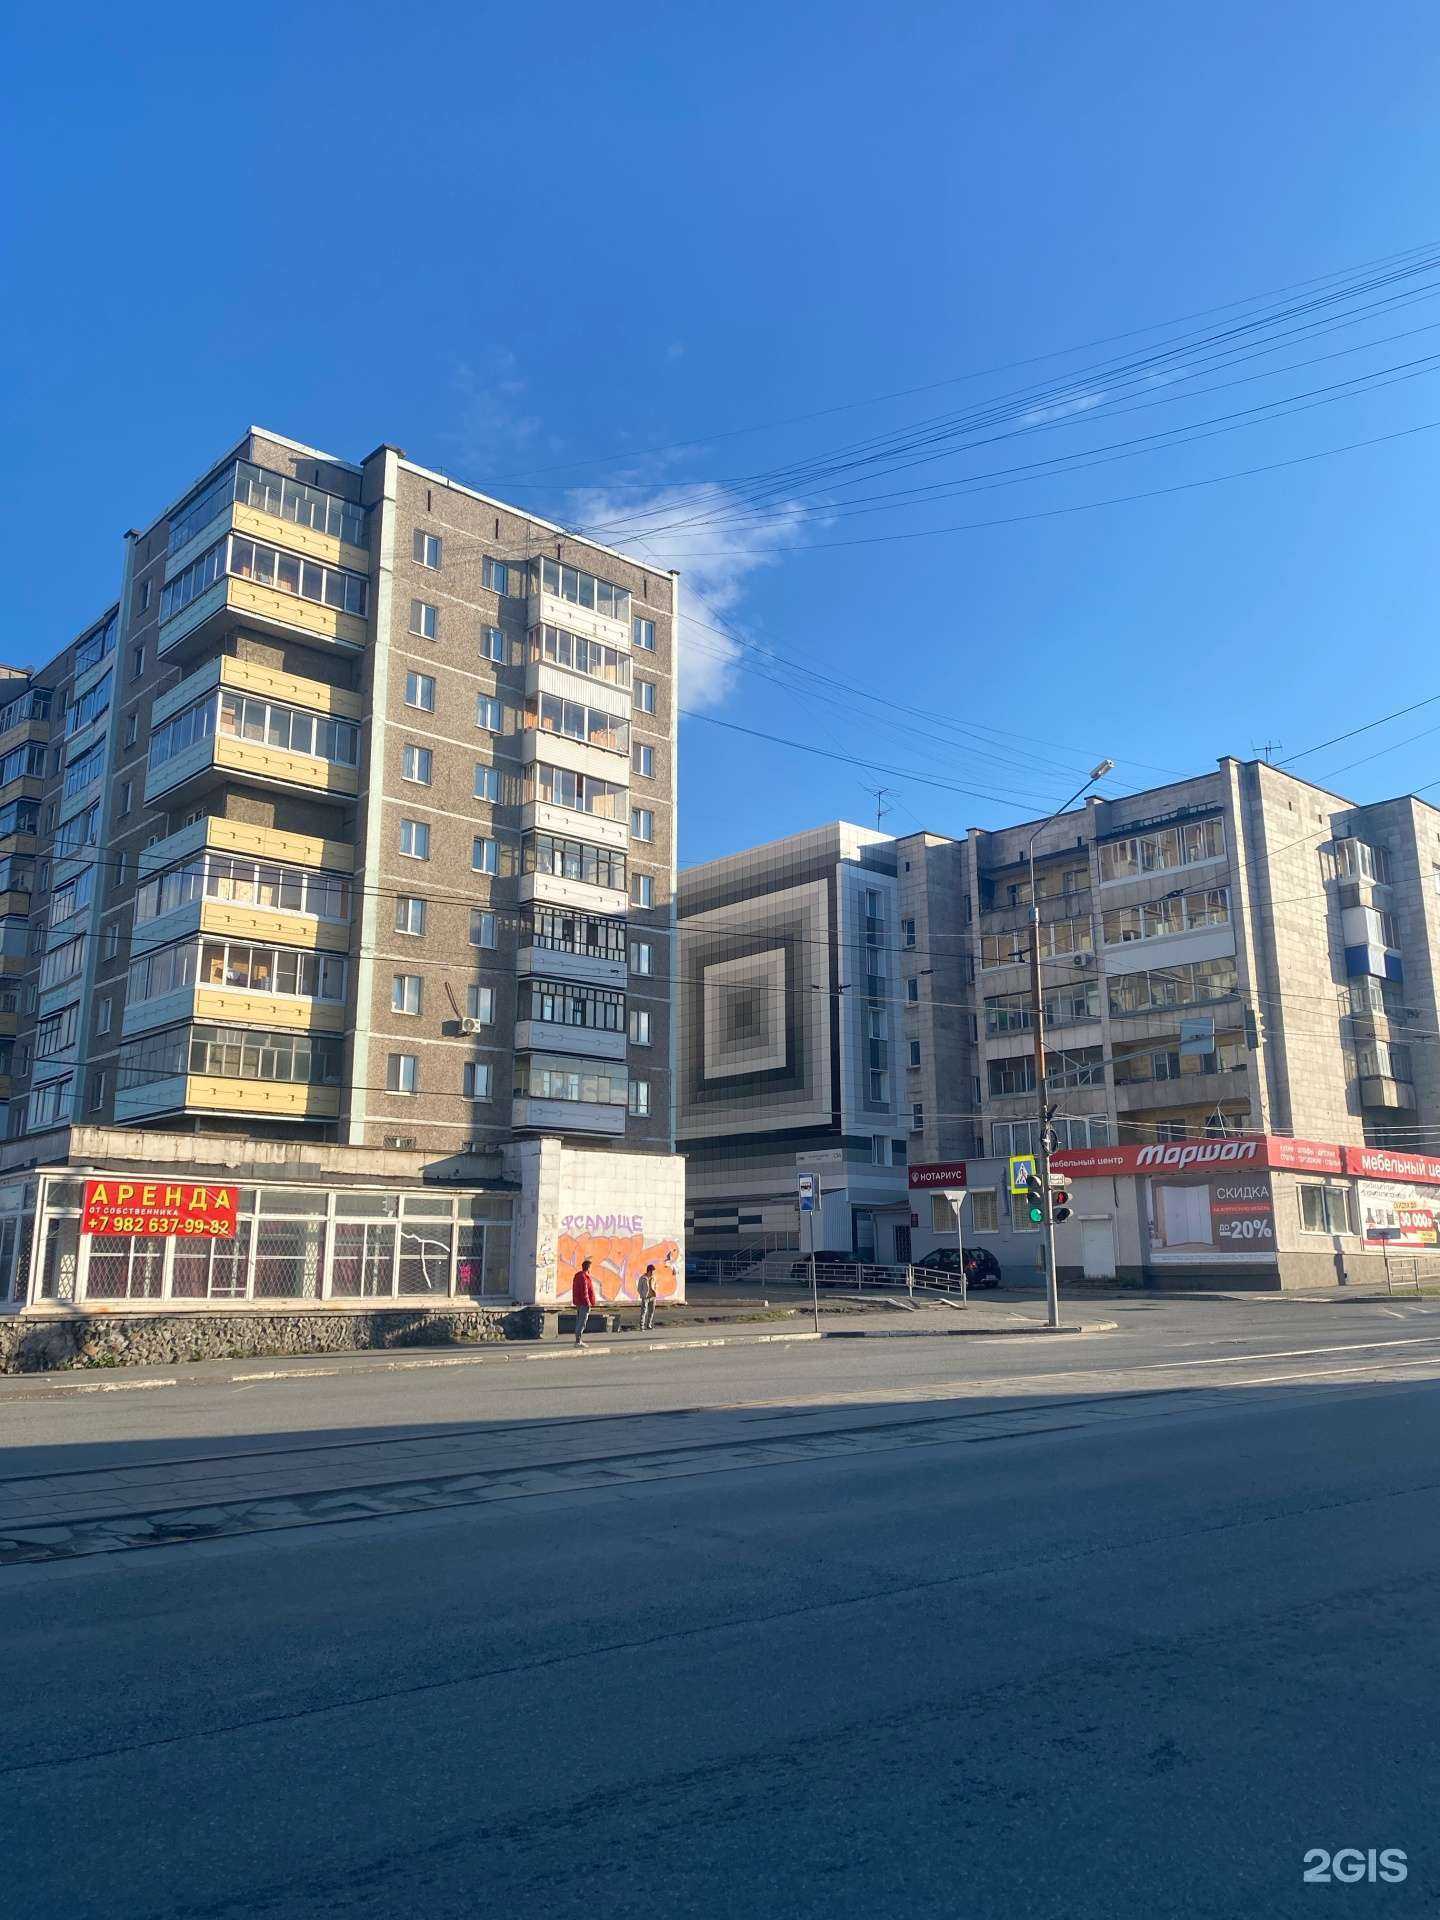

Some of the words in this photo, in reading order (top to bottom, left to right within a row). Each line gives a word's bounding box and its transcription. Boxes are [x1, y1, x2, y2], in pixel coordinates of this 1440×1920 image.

[1097, 1156, 1124, 1167] центр
[1136, 1142, 1257, 1169] Маршал
[1362, 1154, 1426, 1176] мебельный
[920, 1170, 962, 1181] НОТАРИУС
[91, 1183, 231, 1211] АРЕНДА
[1216, 1186, 1270, 1200] СКИДКА
[89, 1206, 101, 1215] ОТ
[103, 1207, 179, 1216] СОБСТВЕННИКА
[88, 1216, 109, 1232] +7
[113, 1217, 144, 1233] 982
[148, 1217, 230, 1236] 637-99-82
[1219, 1223, 1230, 1232] ДО
[1230, 1219, 1273, 1239] 20%
